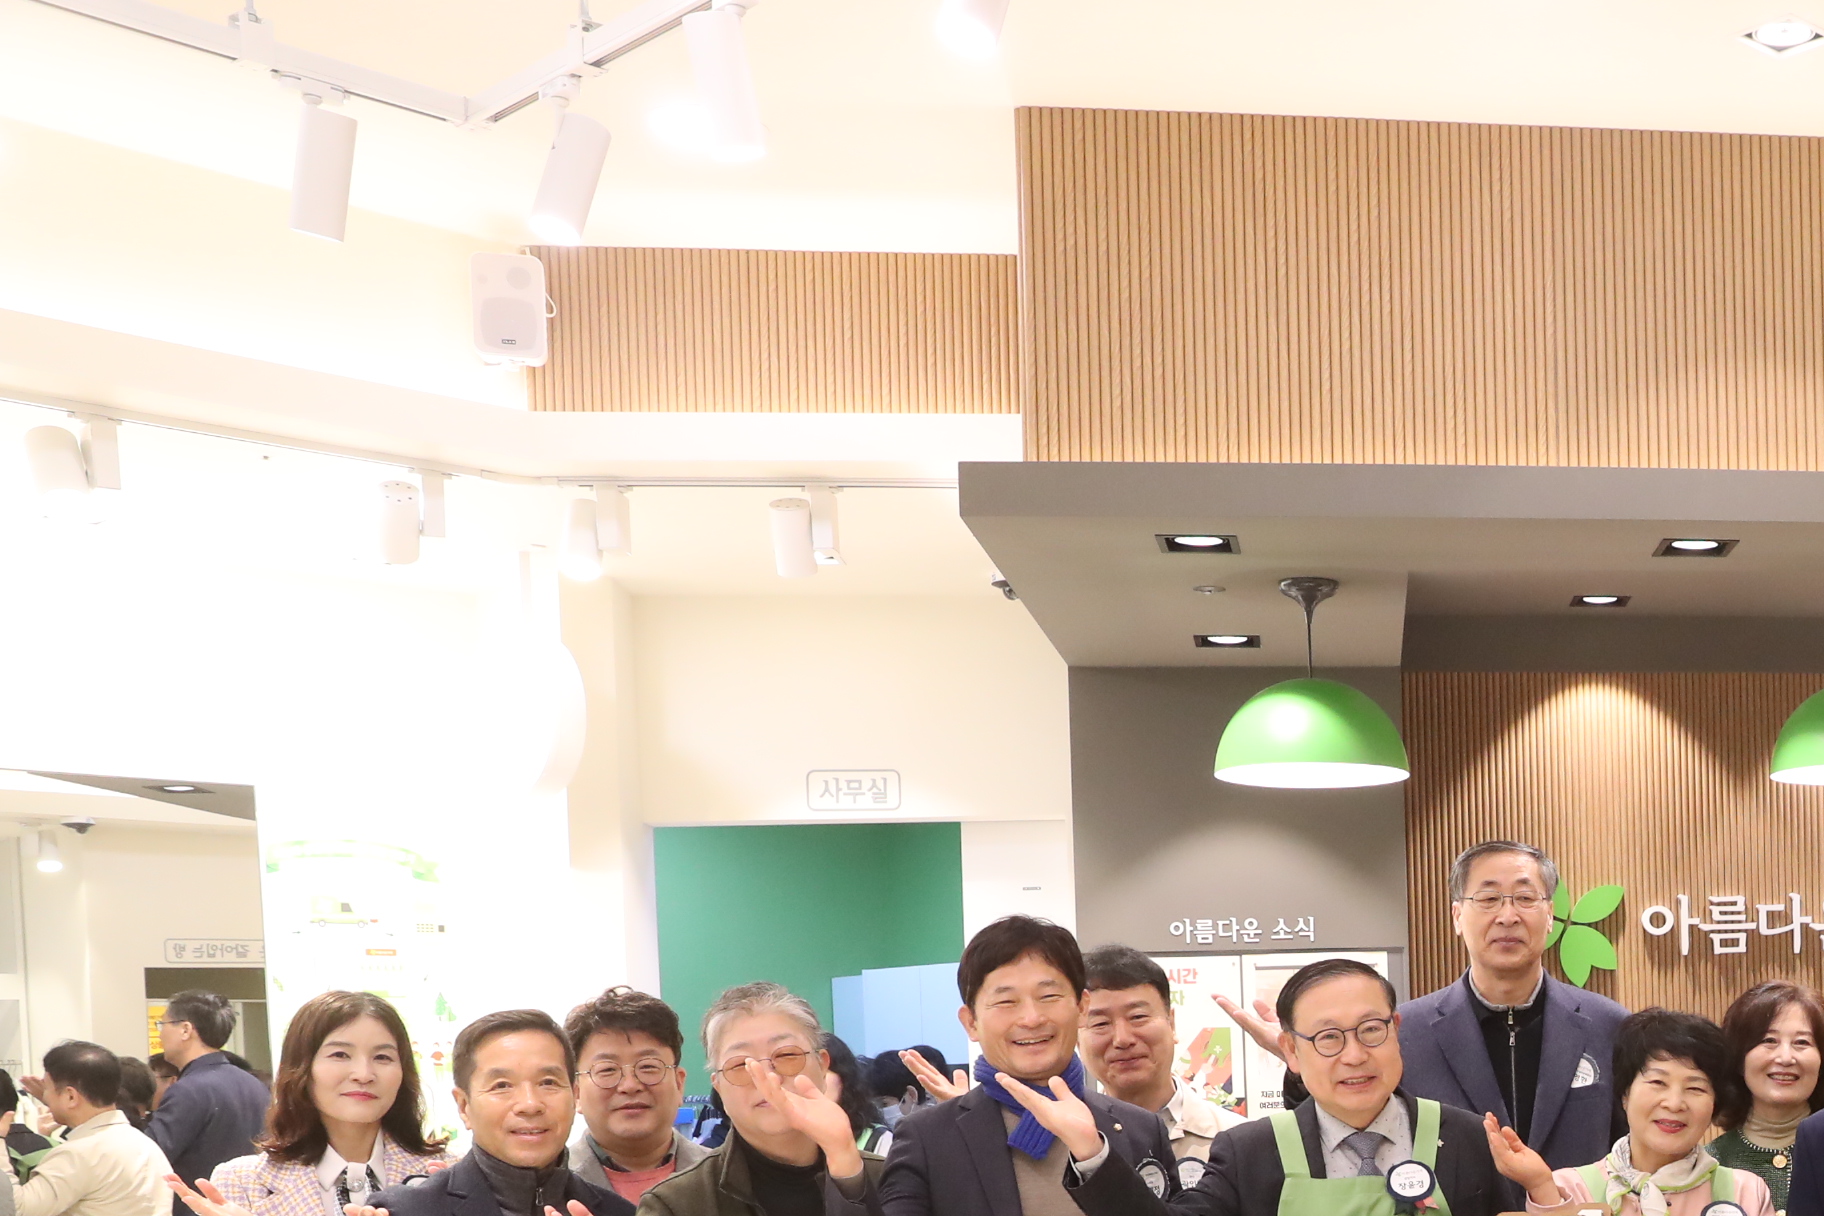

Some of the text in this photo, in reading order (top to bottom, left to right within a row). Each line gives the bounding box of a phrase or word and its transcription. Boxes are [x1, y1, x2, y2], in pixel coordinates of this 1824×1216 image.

[818, 777, 888, 804] 사무실
[1169, 916, 1316, 944] 아름다운 소식
